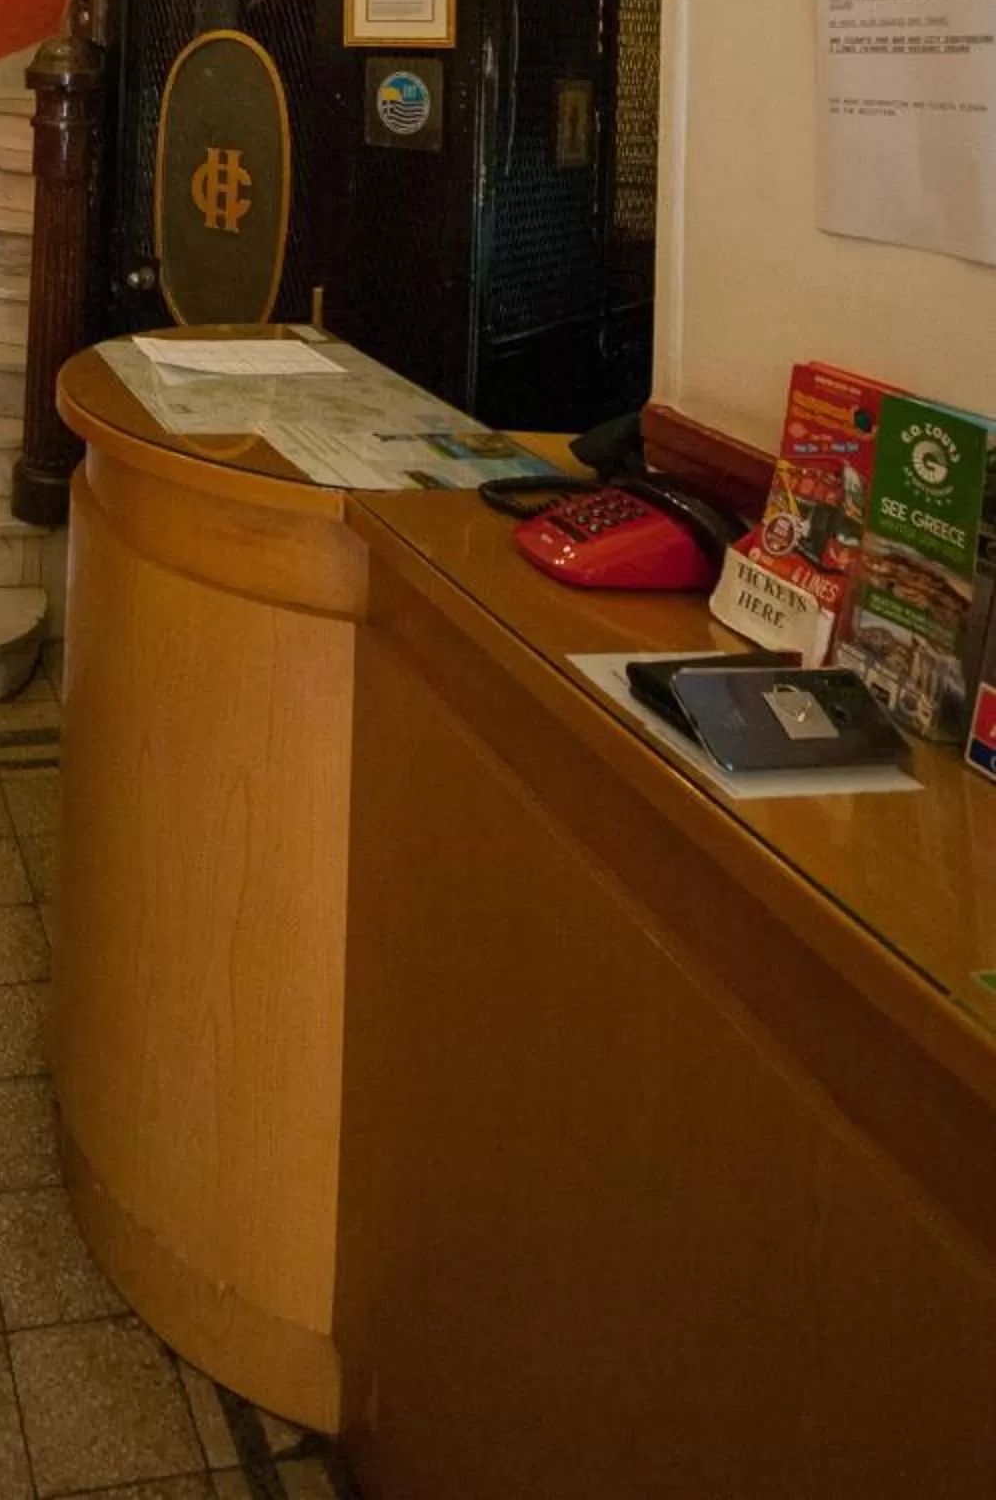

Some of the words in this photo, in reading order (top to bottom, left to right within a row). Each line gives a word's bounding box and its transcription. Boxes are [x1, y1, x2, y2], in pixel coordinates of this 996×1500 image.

[880, 496, 908, 522] SEE
[911, 509, 966, 549] GREECE
[735, 562, 808, 613] TICKETS
[737, 589, 784, 629] HERE
